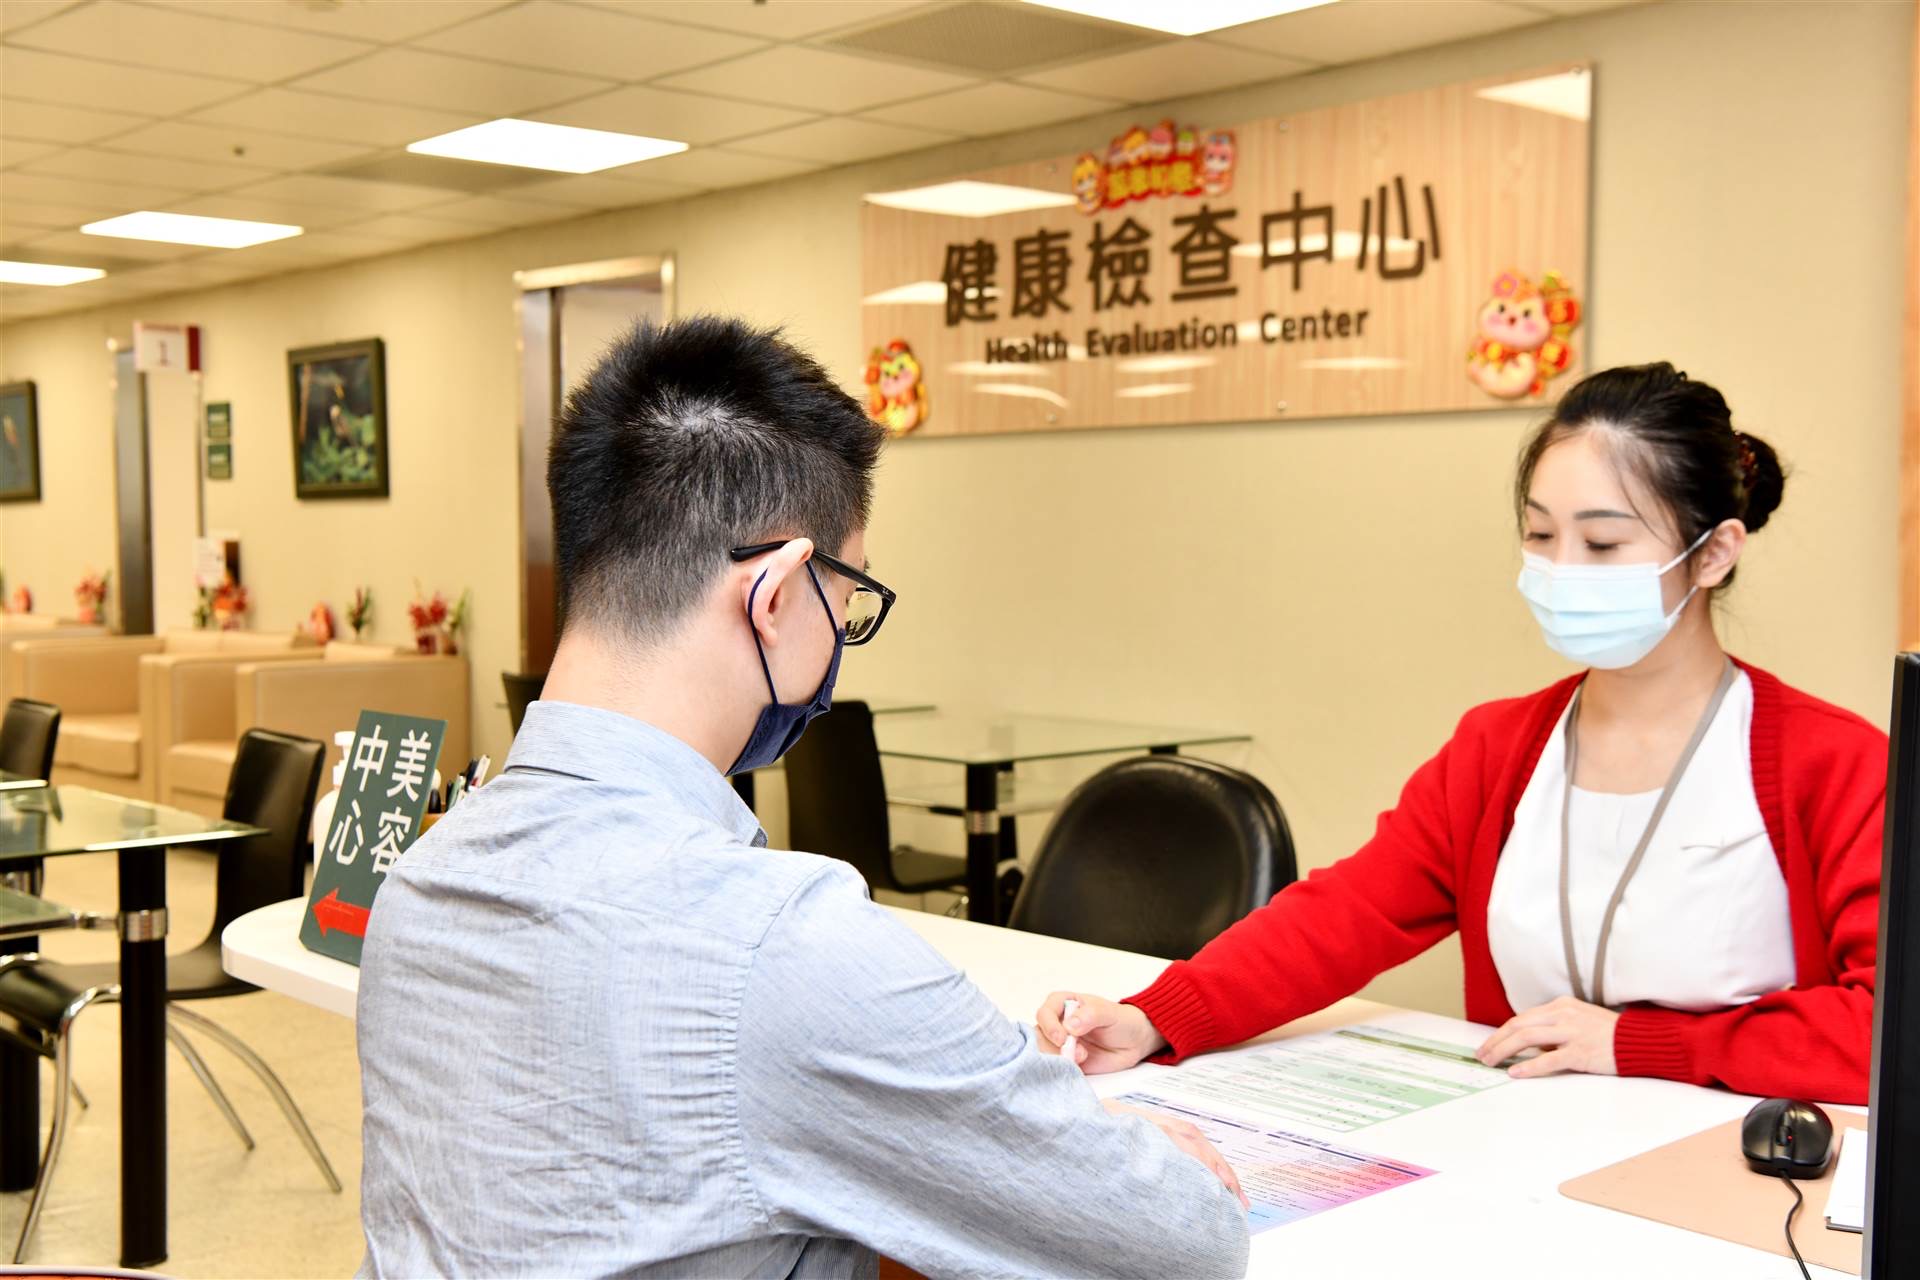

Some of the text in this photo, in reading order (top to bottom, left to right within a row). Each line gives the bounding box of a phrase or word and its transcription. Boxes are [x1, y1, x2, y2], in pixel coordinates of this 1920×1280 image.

[941, 176, 1440, 327] 健康檢查中心
[986, 308, 1369, 364] Health Evaluation Center
[329, 725, 389, 865] 中心
[370, 729, 432, 874] 美容
